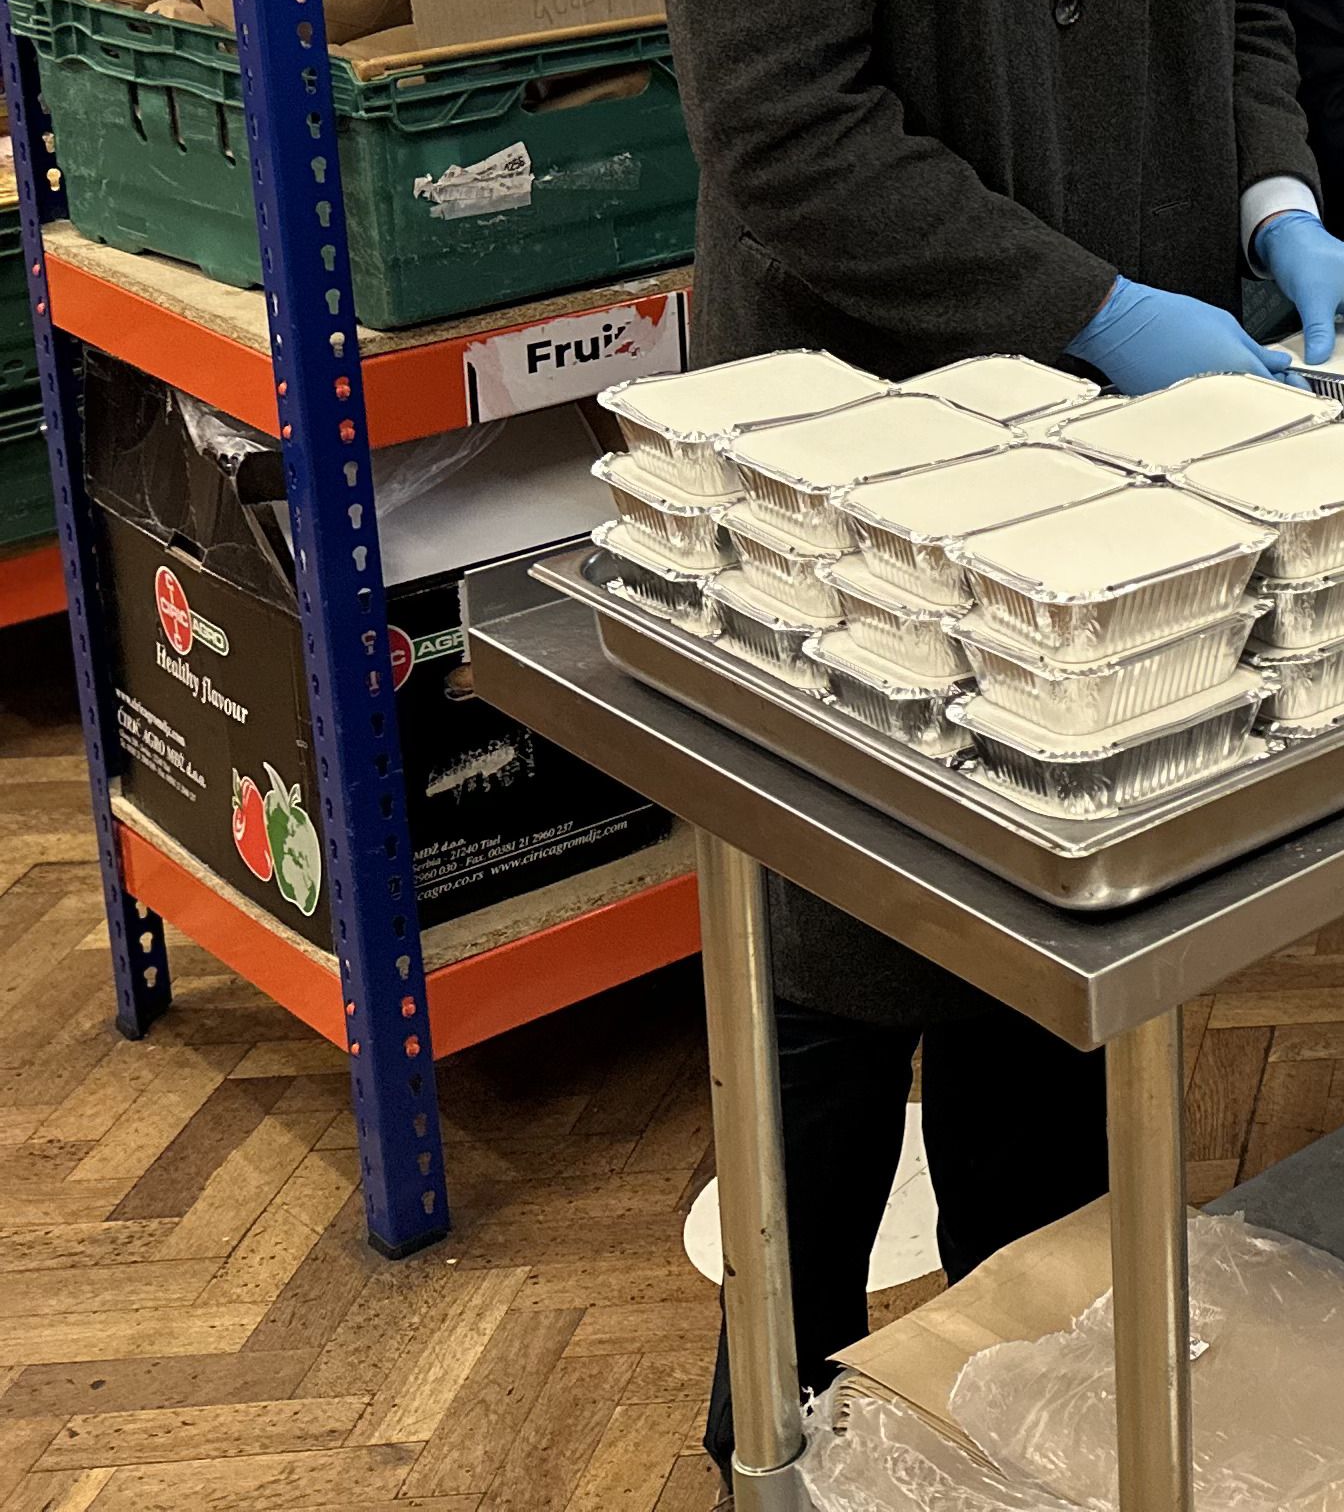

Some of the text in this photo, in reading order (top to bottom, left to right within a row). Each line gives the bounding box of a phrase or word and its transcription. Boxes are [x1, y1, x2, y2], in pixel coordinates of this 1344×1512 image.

[193, 619, 224, 648] AGRO
[155, 641, 249, 724] Healthy flavour
[465, 853, 486, 869] Fax.
[518, 838, 530, 851] 21
[532, 827, 555, 844] 2960
[556, 821, 575, 836] 237
[490, 820, 629, 877] www.ciricagromdjz.com
